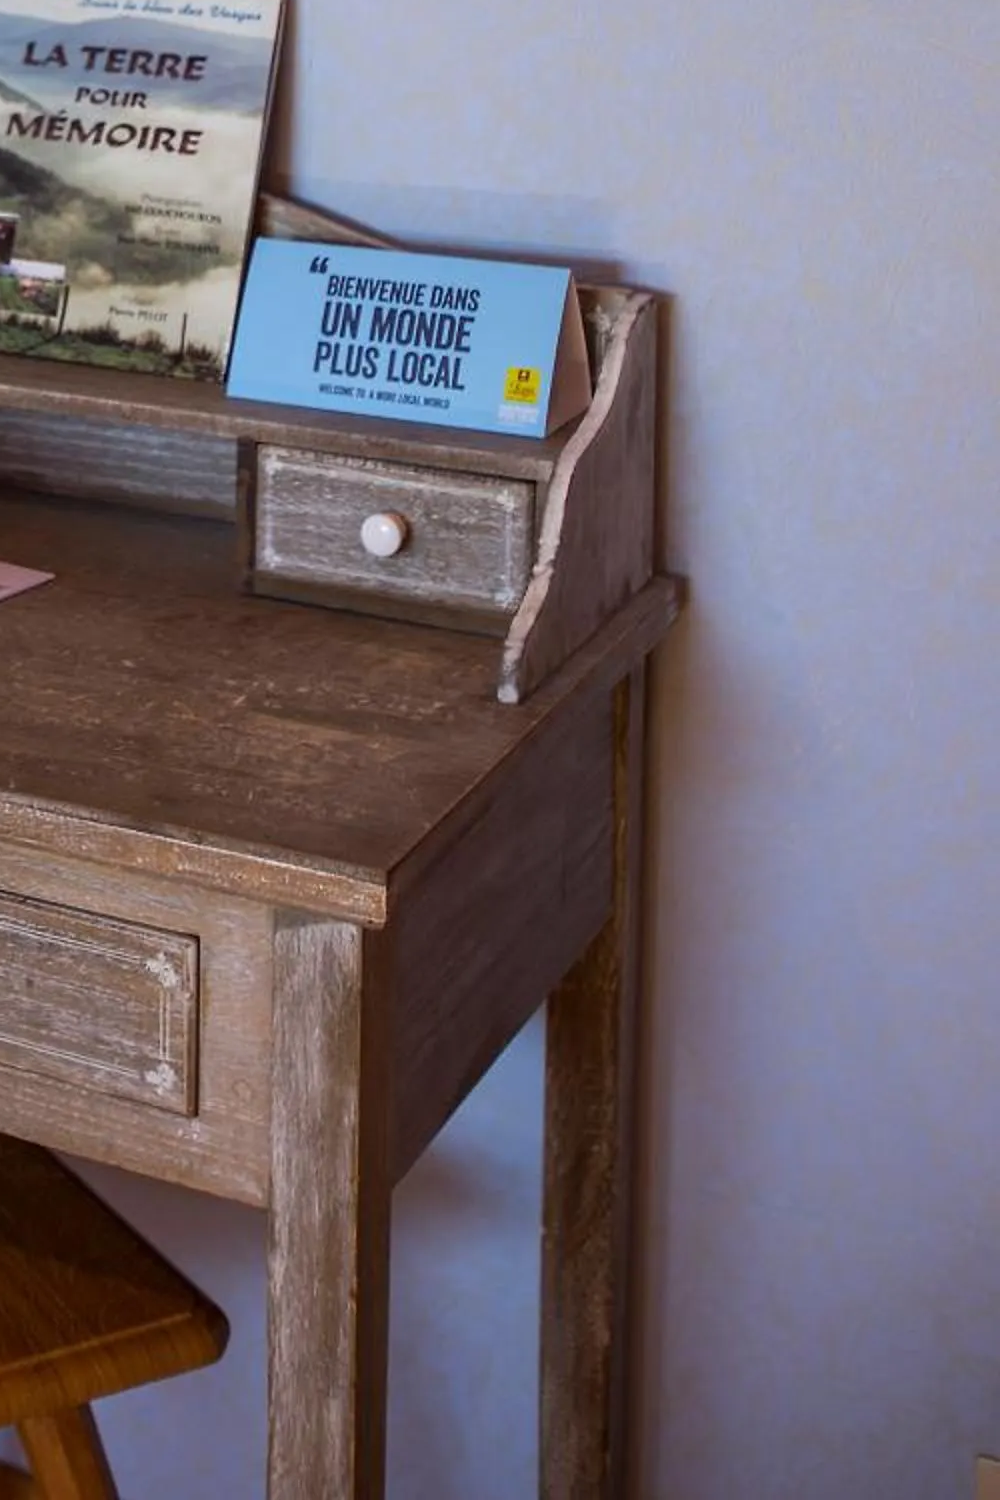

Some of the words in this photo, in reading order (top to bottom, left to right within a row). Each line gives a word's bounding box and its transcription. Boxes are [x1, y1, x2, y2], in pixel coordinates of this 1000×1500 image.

[23, 41, 69, 68] LA
[80, 45, 208, 81] TERRE
[75, 86, 148, 109] POUR
[6, 109, 204, 156] MÉMOIRE
[327, 275, 428, 307] BIENVENUE
[429, 285, 481, 312] DANS
[321, 301, 363, 340] UN
[369, 306, 475, 353] MONDE
[313, 341, 380, 379] PLUS
[386, 349, 466, 391] LOCAL
[319, 383, 354, 397] WELCOME
